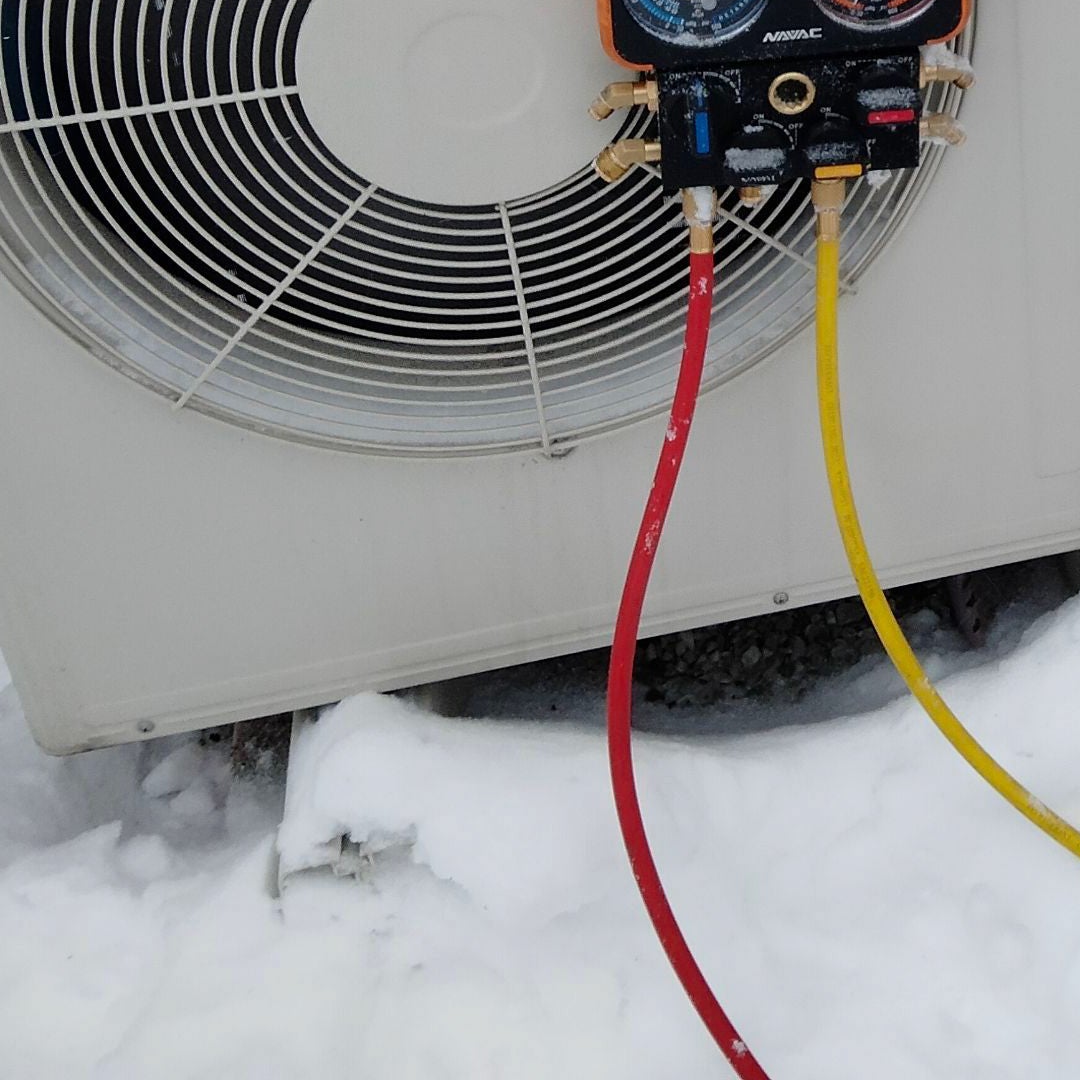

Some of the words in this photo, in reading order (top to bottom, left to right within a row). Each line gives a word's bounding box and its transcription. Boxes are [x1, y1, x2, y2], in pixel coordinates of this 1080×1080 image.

[762, 27, 823, 43] NAVAC
[897, 56, 914, 64] OFF
[724, 68, 741, 76] OFF
